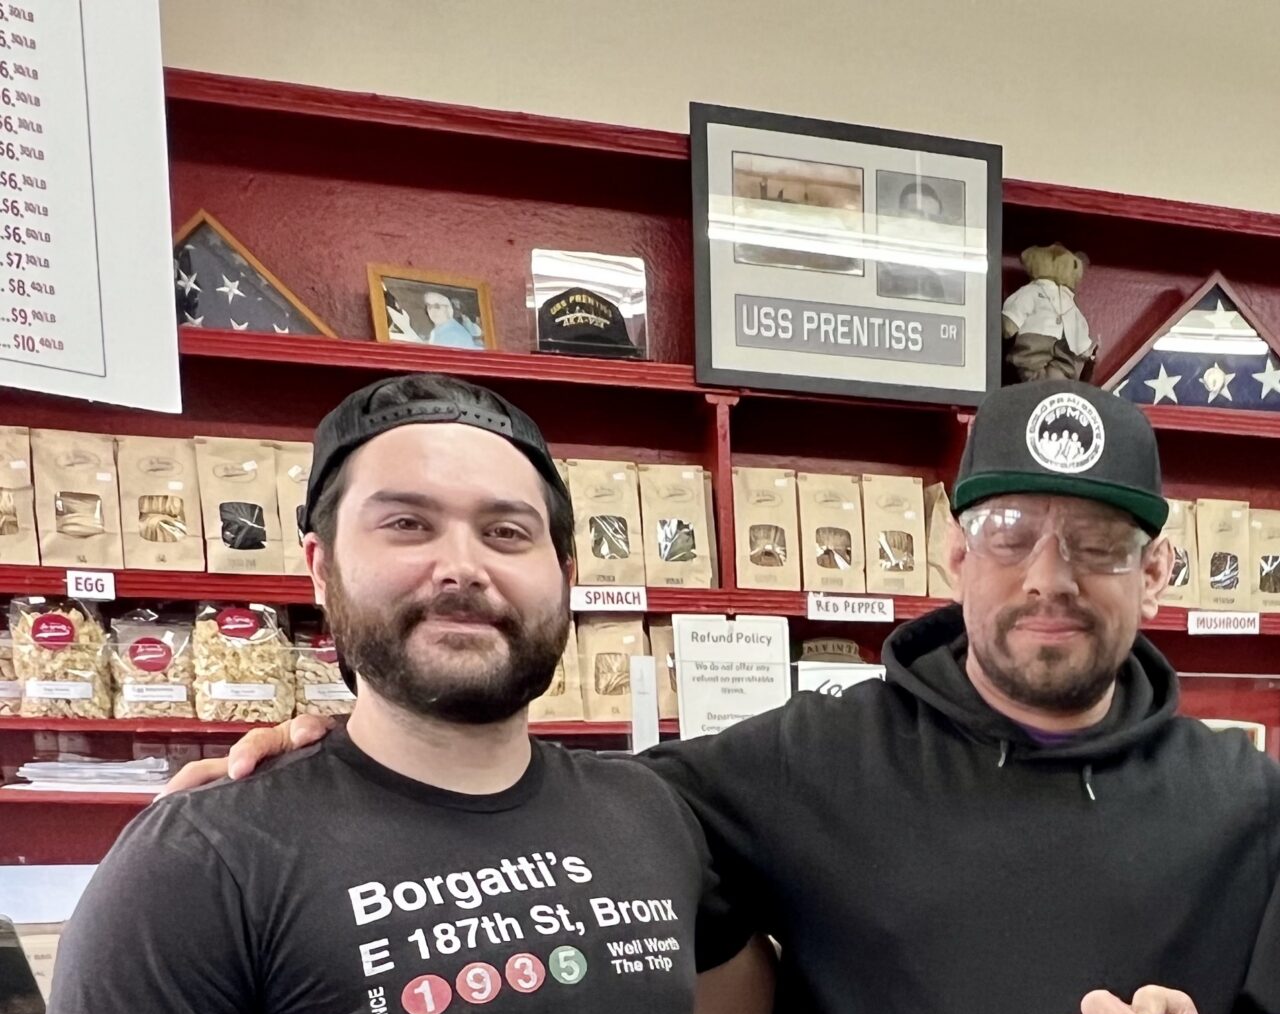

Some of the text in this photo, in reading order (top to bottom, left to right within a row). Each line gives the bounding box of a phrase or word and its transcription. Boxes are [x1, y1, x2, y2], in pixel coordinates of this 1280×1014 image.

[742, 304, 793, 339] USS
[802, 311, 923, 351] PRENTISS
[75, 576, 105, 592] EGG
[585, 591, 641, 605] SPINACH
[816, 599, 887, 615] RED PEPPER
[1196, 617, 1256, 629] MUSHROOM
[691, 631, 772, 646] Refund Policy
[710, 661, 719, 671] do
[721, 661, 733, 671] not
[735, 662, 753, 671] offer
[348, 852, 593, 925] Borgatti's
[359, 897, 679, 976] E 187th St, Bronx
[606, 936, 680, 957] Well Worth
[611, 955, 673, 974] The Trip
